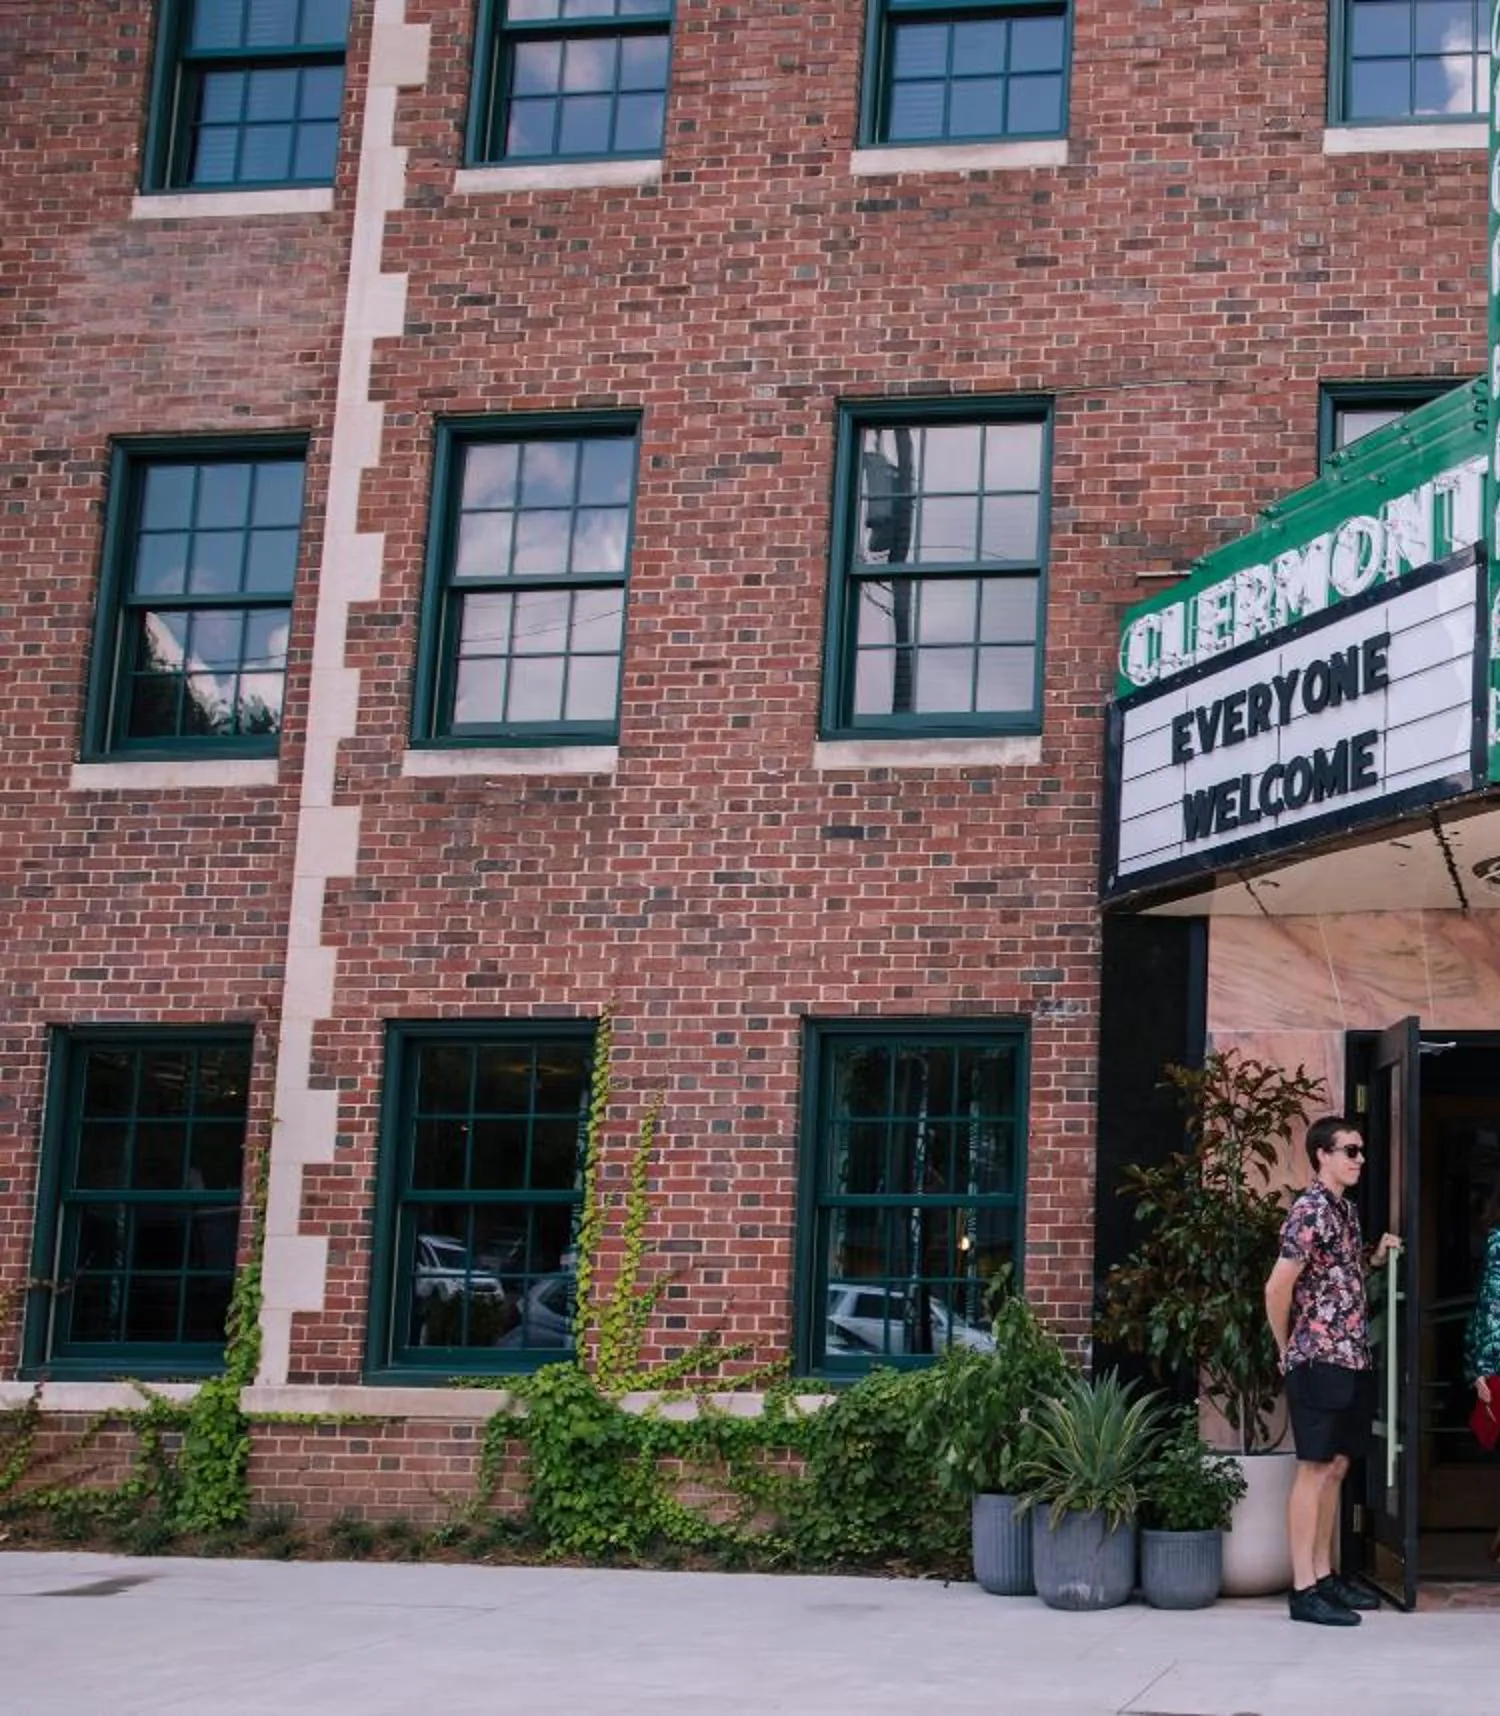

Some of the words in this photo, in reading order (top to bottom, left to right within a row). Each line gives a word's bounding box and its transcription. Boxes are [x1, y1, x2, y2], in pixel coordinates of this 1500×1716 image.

[1119, 455, 1489, 686] CLERMONT
[1171, 632, 1391, 765] EVERYONE
[1182, 729, 1380, 842] WELCOME
